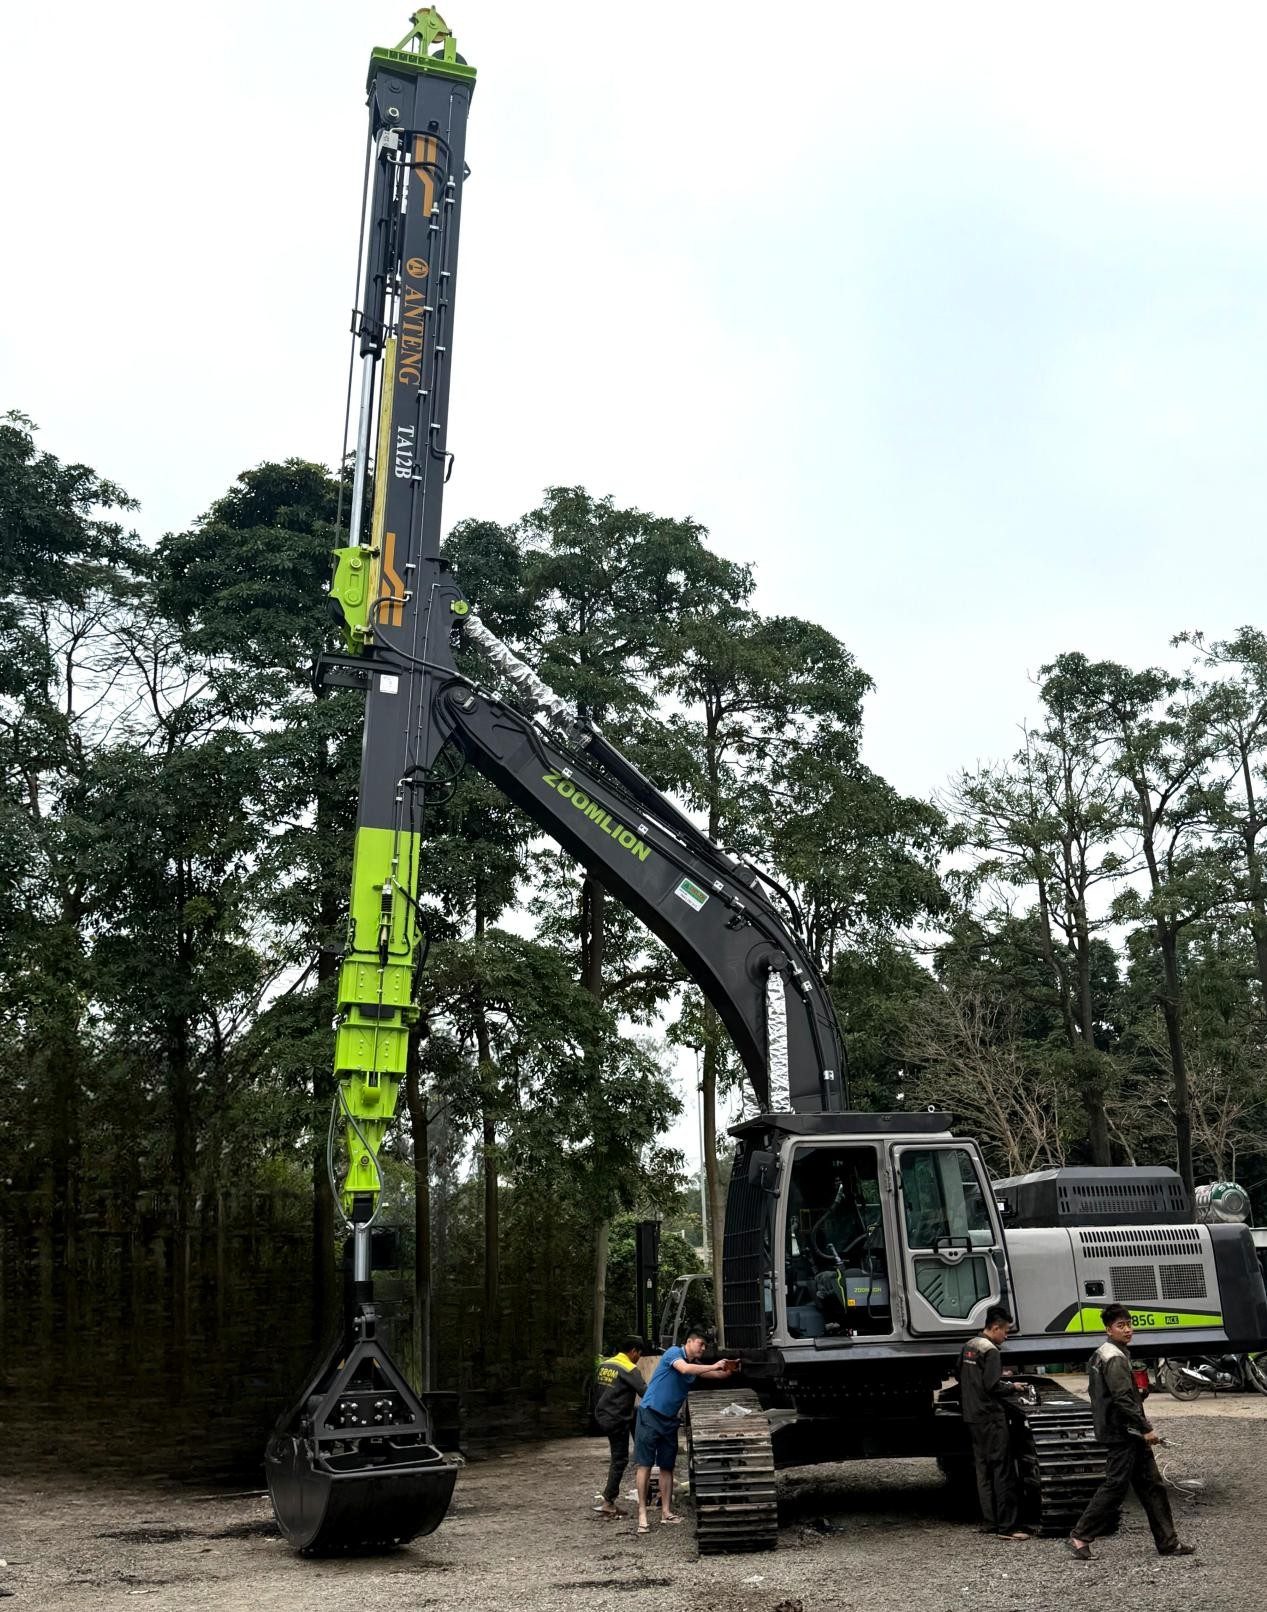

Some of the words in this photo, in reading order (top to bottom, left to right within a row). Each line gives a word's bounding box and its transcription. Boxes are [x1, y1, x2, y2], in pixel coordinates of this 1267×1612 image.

[399, 284, 426, 386] ANTENG
[542, 767, 652, 862] ZOOMLION
[1131, 1314, 1155, 1326] 85G
